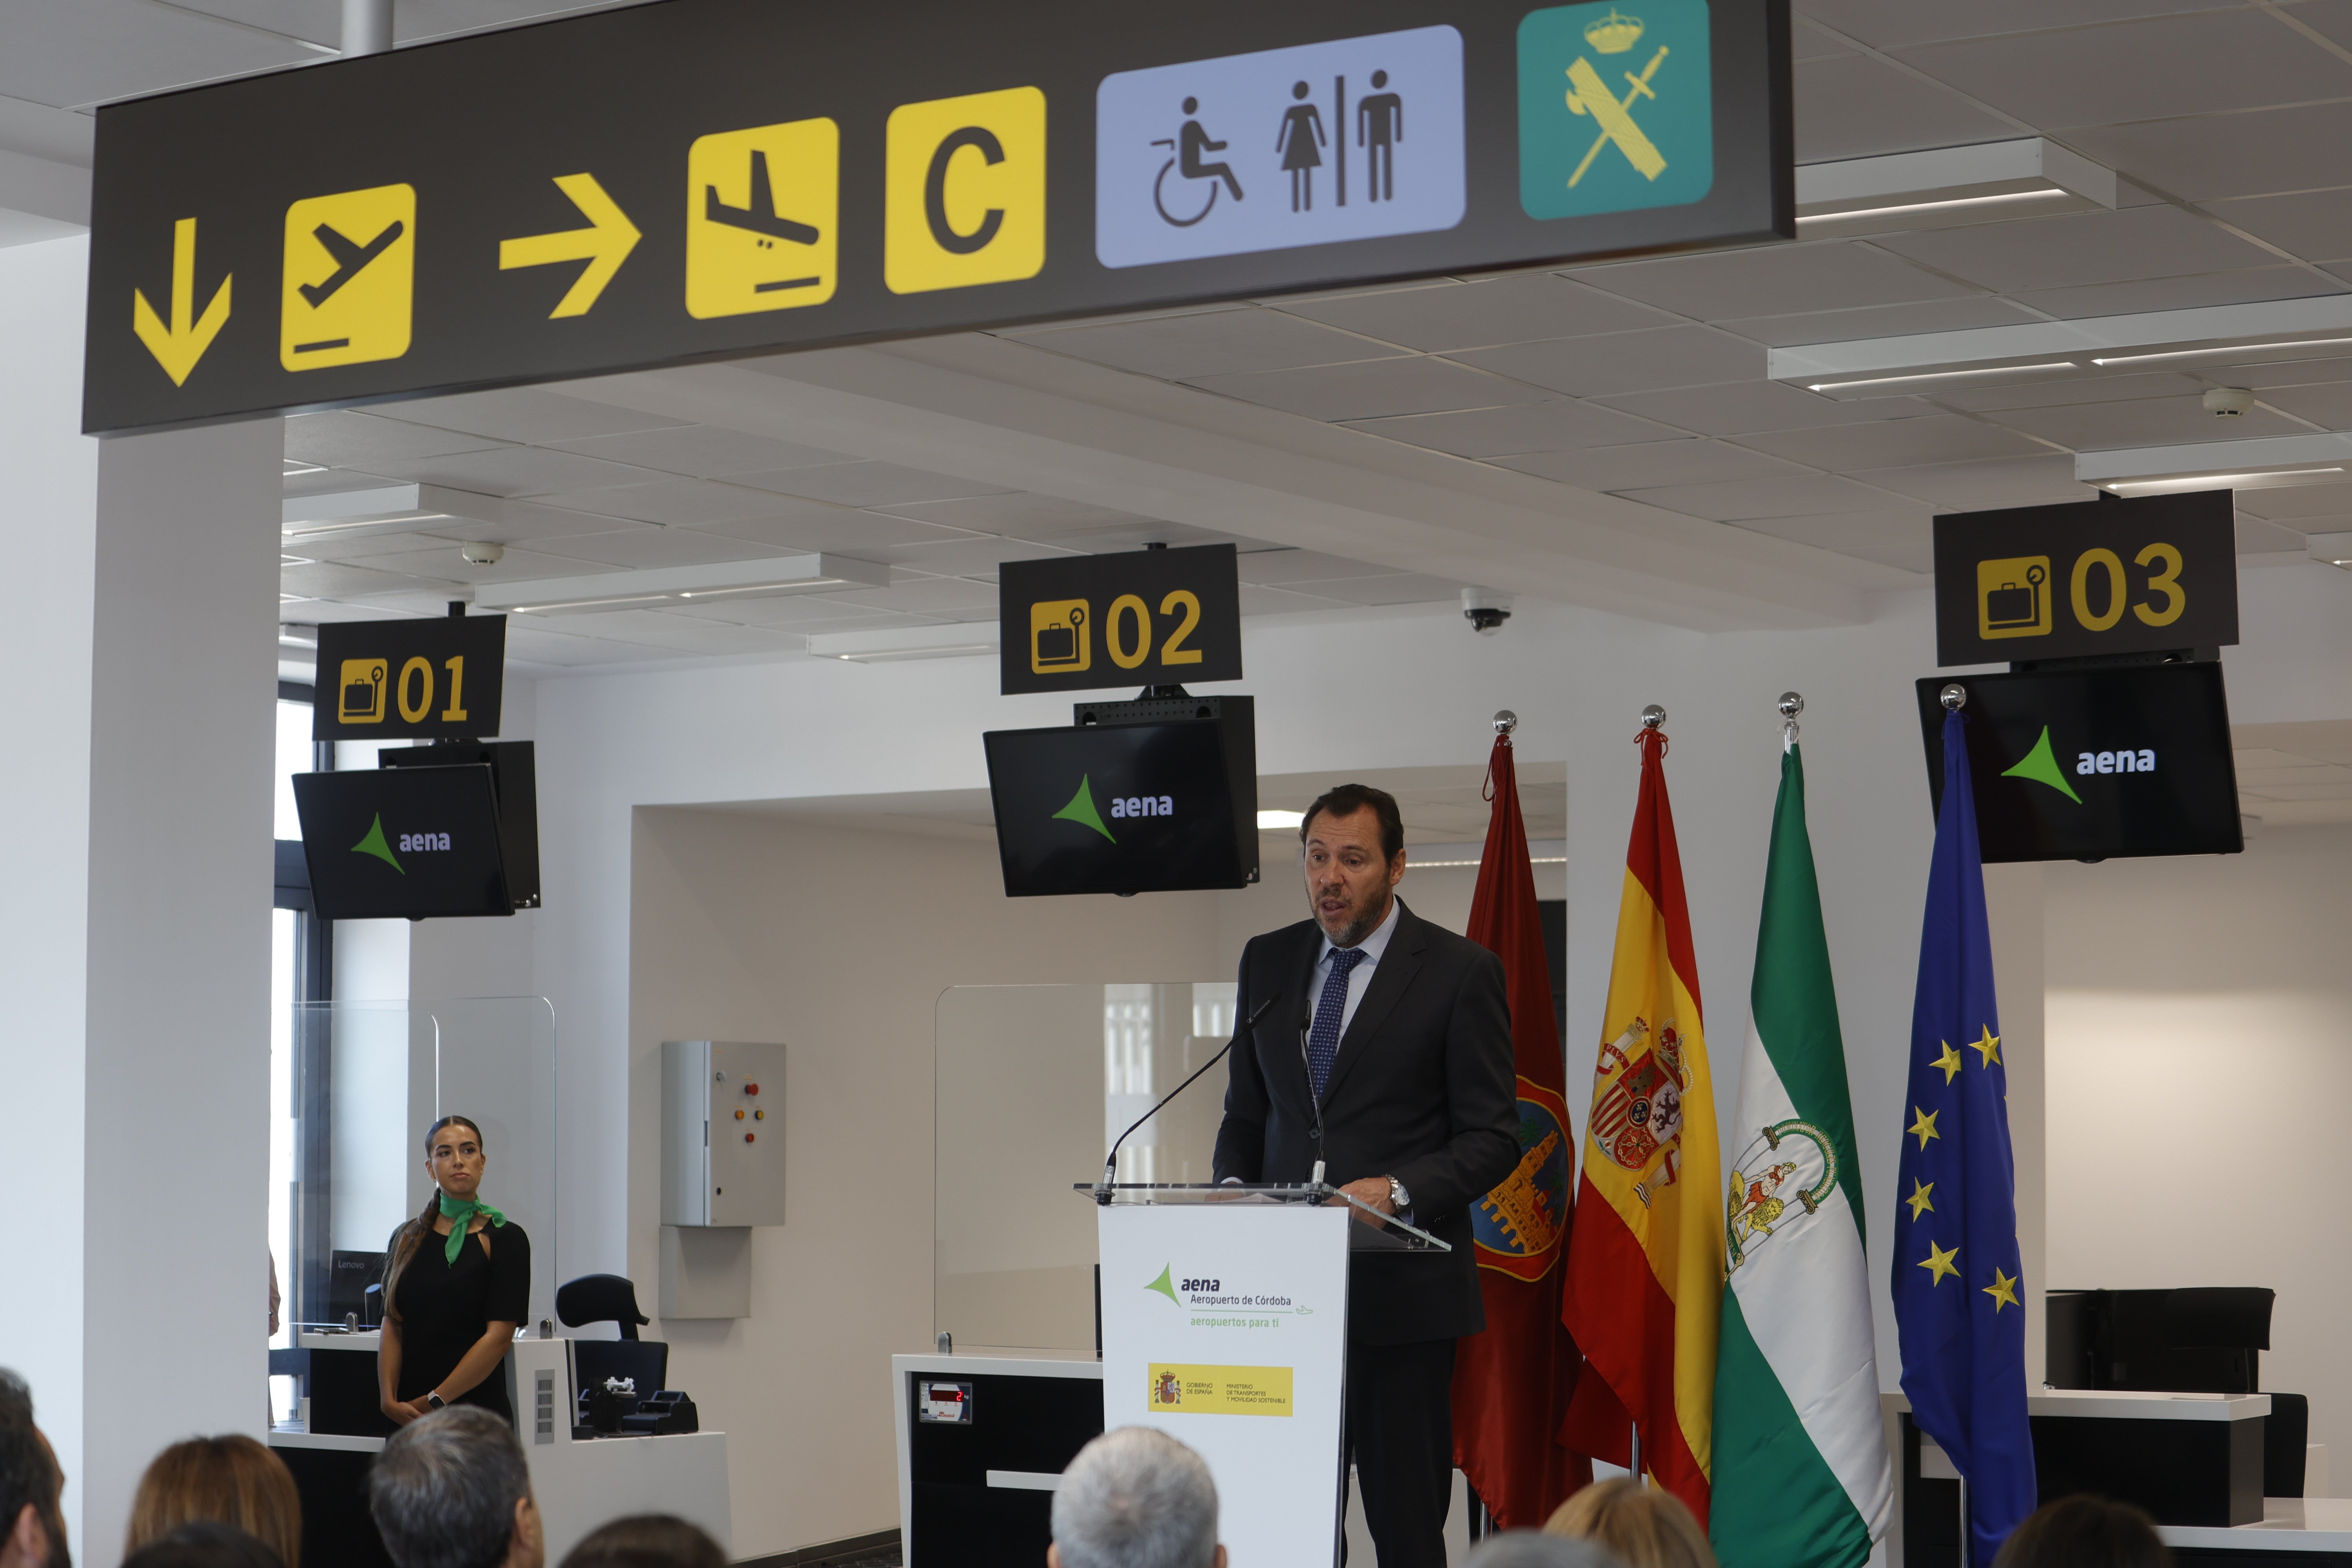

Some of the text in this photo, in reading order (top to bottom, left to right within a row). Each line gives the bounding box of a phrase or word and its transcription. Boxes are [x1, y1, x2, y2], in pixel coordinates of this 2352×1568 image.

[924, 126, 1005, 255] C
[2070, 543, 2186, 631] 03
[1105, 590, 1203, 669] 02
[397, 655, 467, 724] 01
[2076, 748, 2156, 775] aena
[1111, 795, 1173, 818] aena
[399, 832, 450, 852] aena
[338, 1259, 364, 1269] Lenovo
[1181, 1278, 1220, 1292] aena
[1191, 1294, 1291, 1306] Aeropuerto de Córdoba
[1191, 1318, 1279, 1329] aeropuertos para ti
[956, 1391, 963, 1401] 2
